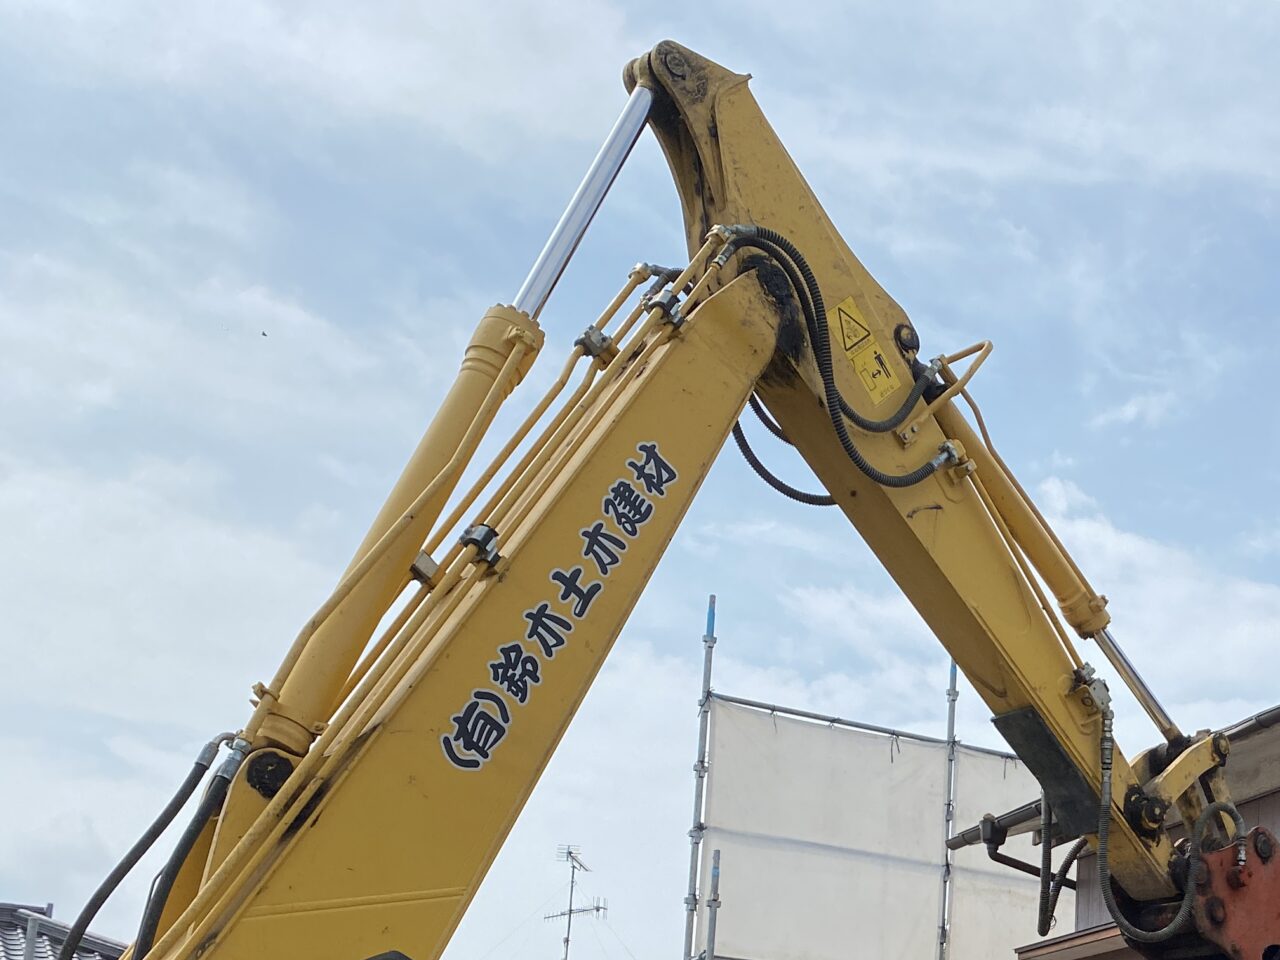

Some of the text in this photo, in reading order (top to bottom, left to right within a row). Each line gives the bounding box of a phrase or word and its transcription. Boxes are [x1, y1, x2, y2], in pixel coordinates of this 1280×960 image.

[442, 444, 677, 769] (有)鈴木土木建材
